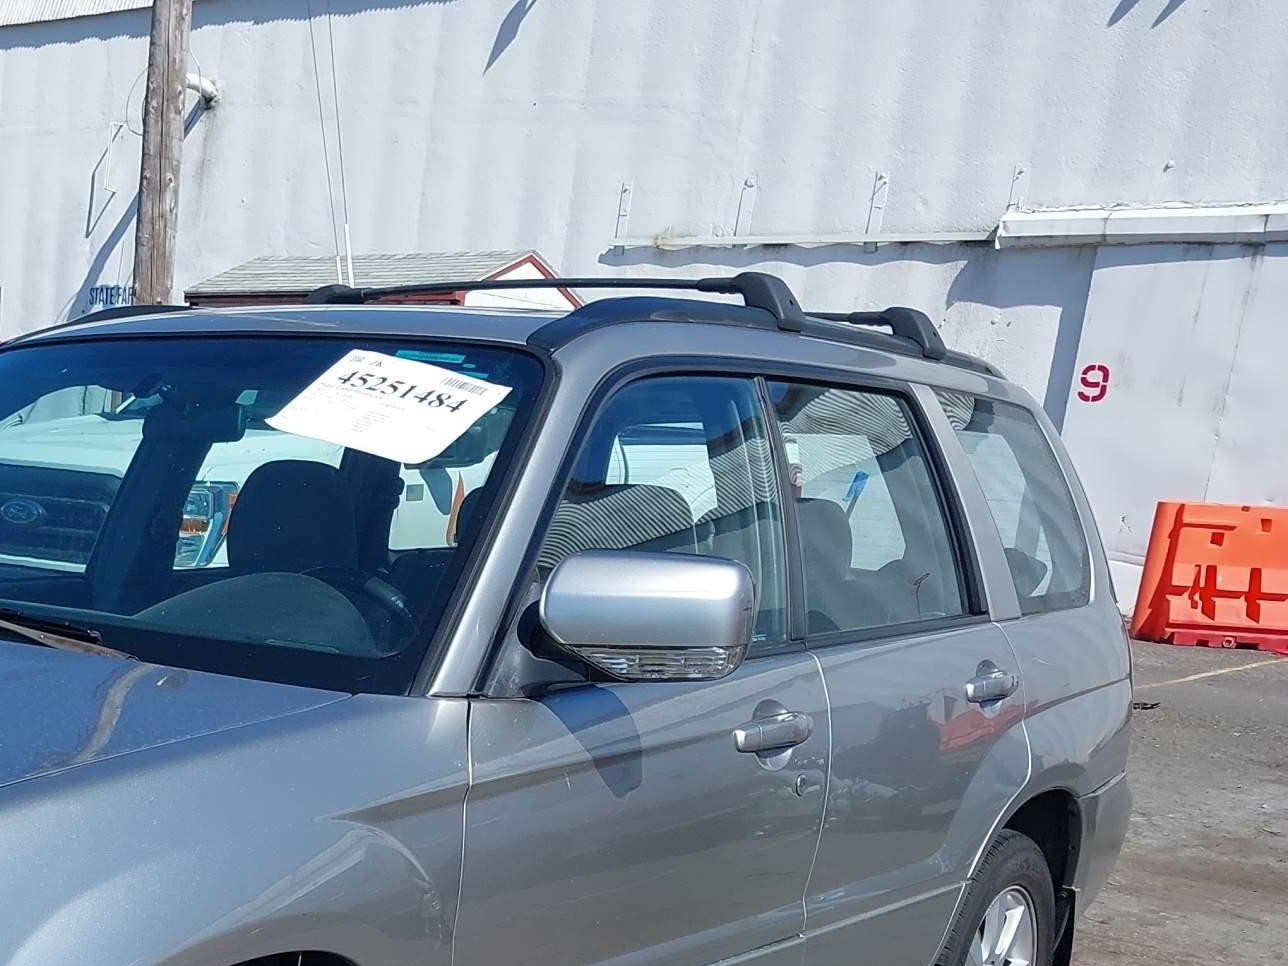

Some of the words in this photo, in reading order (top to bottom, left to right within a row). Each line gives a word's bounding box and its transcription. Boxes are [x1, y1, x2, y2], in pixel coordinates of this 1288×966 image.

[88, 287, 114, 305] STATE
[116, 286, 136, 305] FAR
[338, 370, 468, 413] 45251484
[1078, 364, 1110, 403] 9
